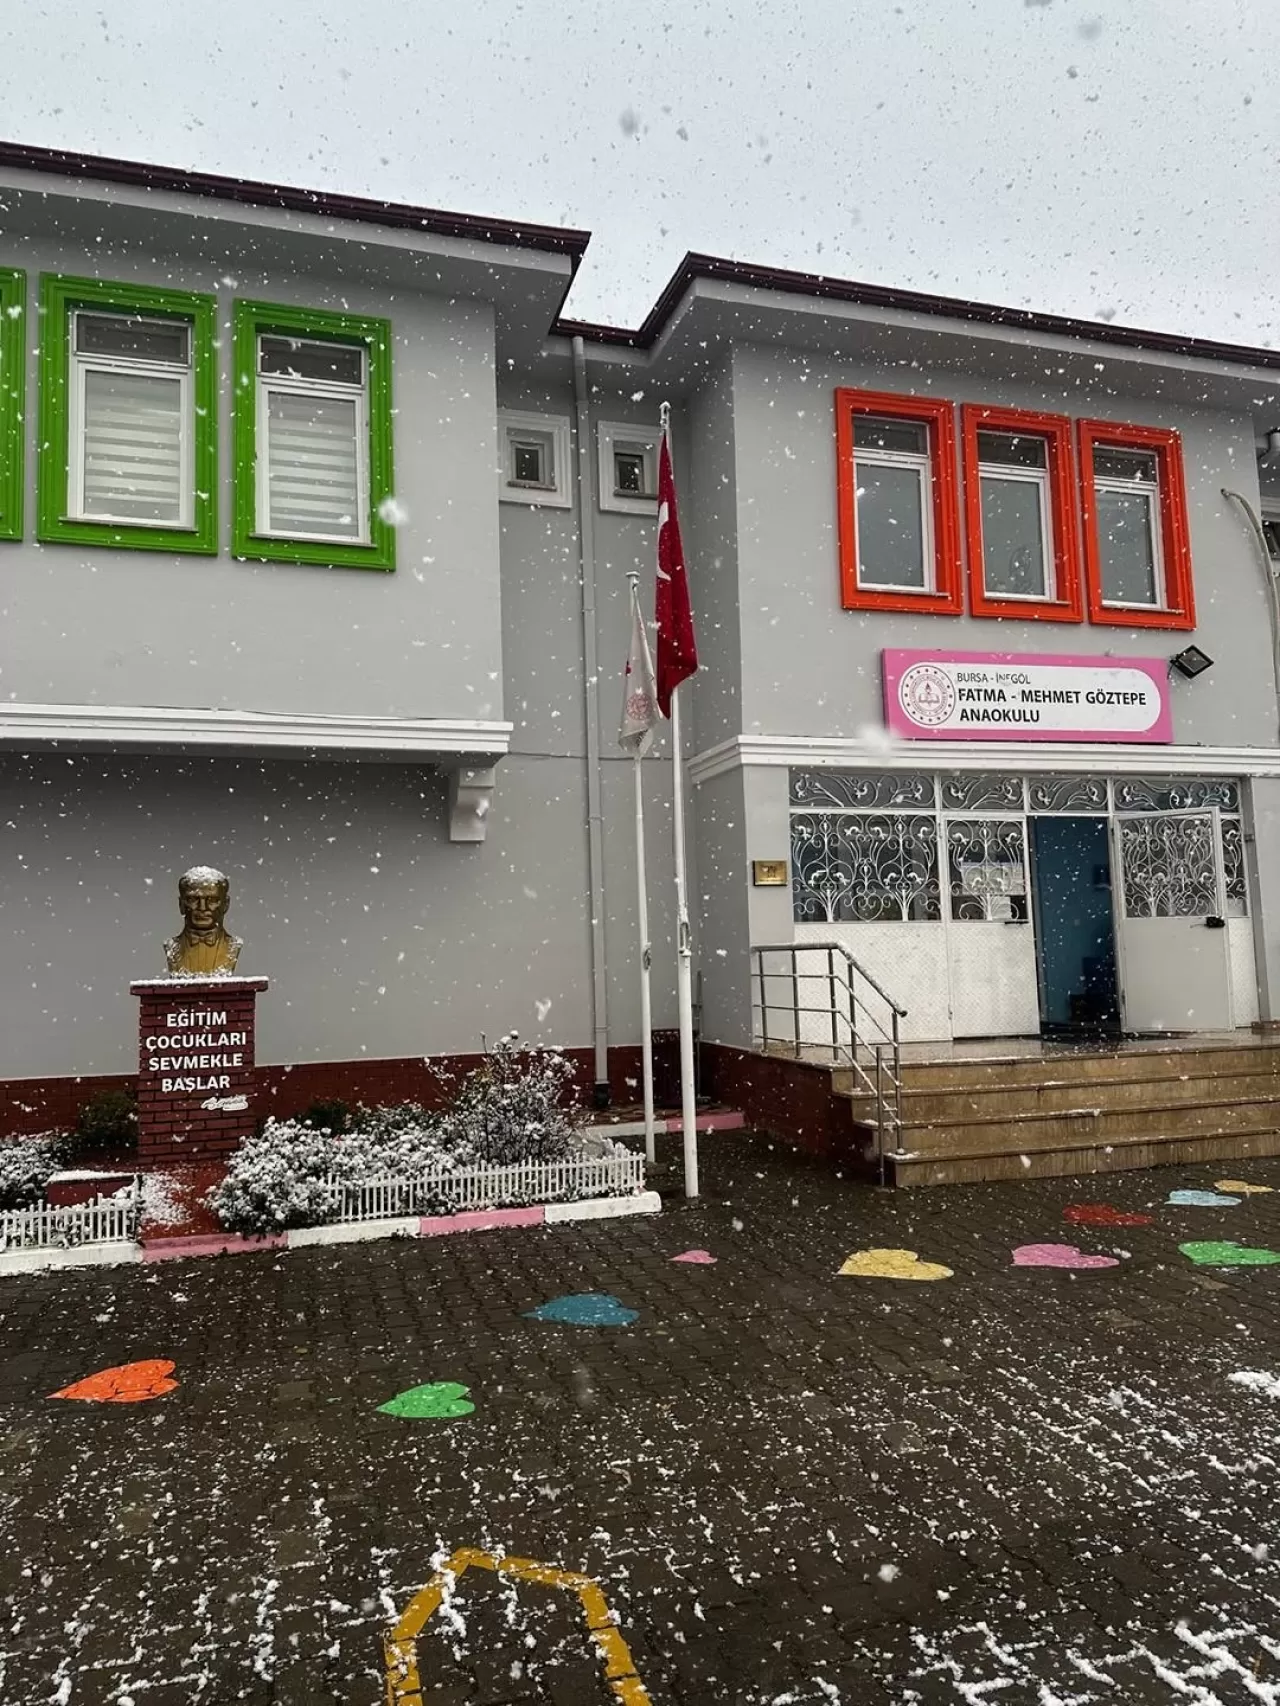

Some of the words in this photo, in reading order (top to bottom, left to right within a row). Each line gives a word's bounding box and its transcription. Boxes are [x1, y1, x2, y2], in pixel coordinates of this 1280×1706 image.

[957, 672, 988, 683] BURSA
[958, 688, 1007, 702] FATMA
[1021, 689, 1081, 704] MEHMET
[1085, 688, 1147, 706] GÖZTEPE
[960, 708, 1040, 723] ANAOKULU
[166, 1008, 227, 1028] EĞİTİM
[145, 1032, 247, 1053] ÇOCUKLARI
[148, 1053, 243, 1072] SEVMEKLE
[161, 1075, 231, 1093] BAŞLAR
